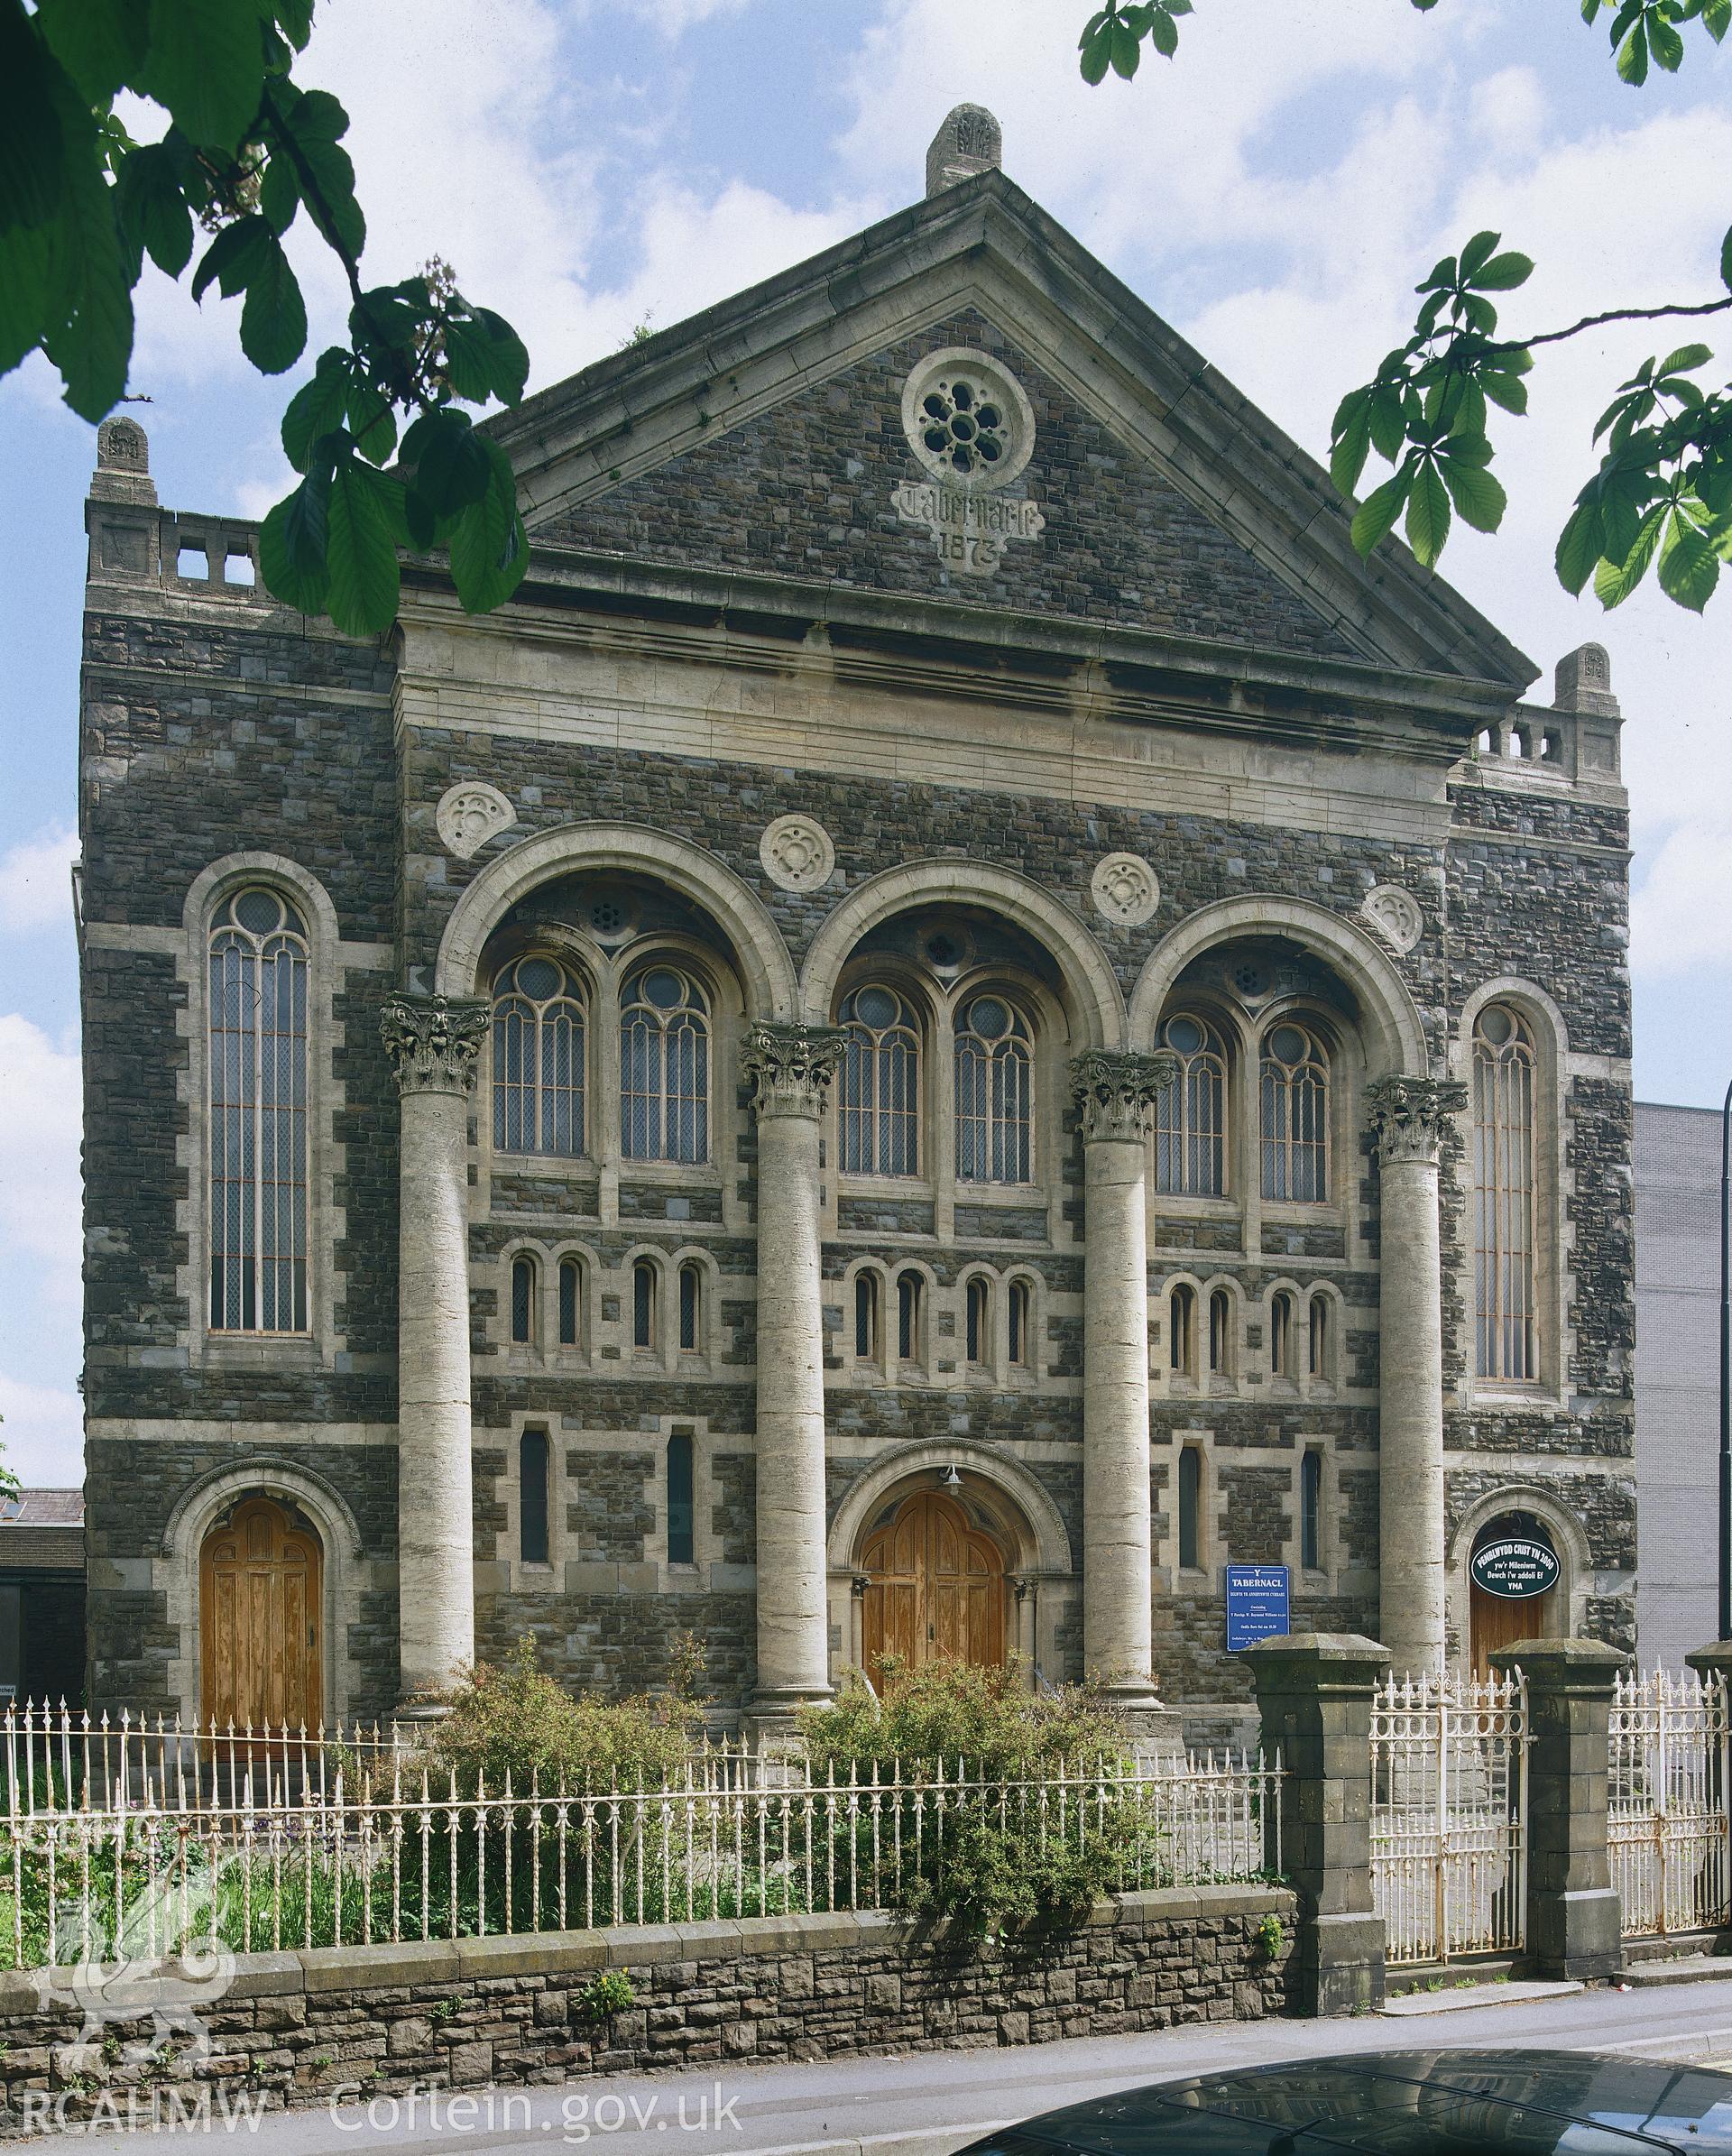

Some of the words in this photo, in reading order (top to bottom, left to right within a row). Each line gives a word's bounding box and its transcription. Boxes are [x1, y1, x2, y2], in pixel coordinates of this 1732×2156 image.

[1514, 1544, 1531, 1556] CRIST
[1539, 1553, 1554, 1571] 2000
[1254, 1569, 1261, 1577] Y
[1487, 1571, 1506, 1579] Dewch
[1536, 1571, 1543, 1580] Ef
[1507, 1582, 1523, 1590] YMA
